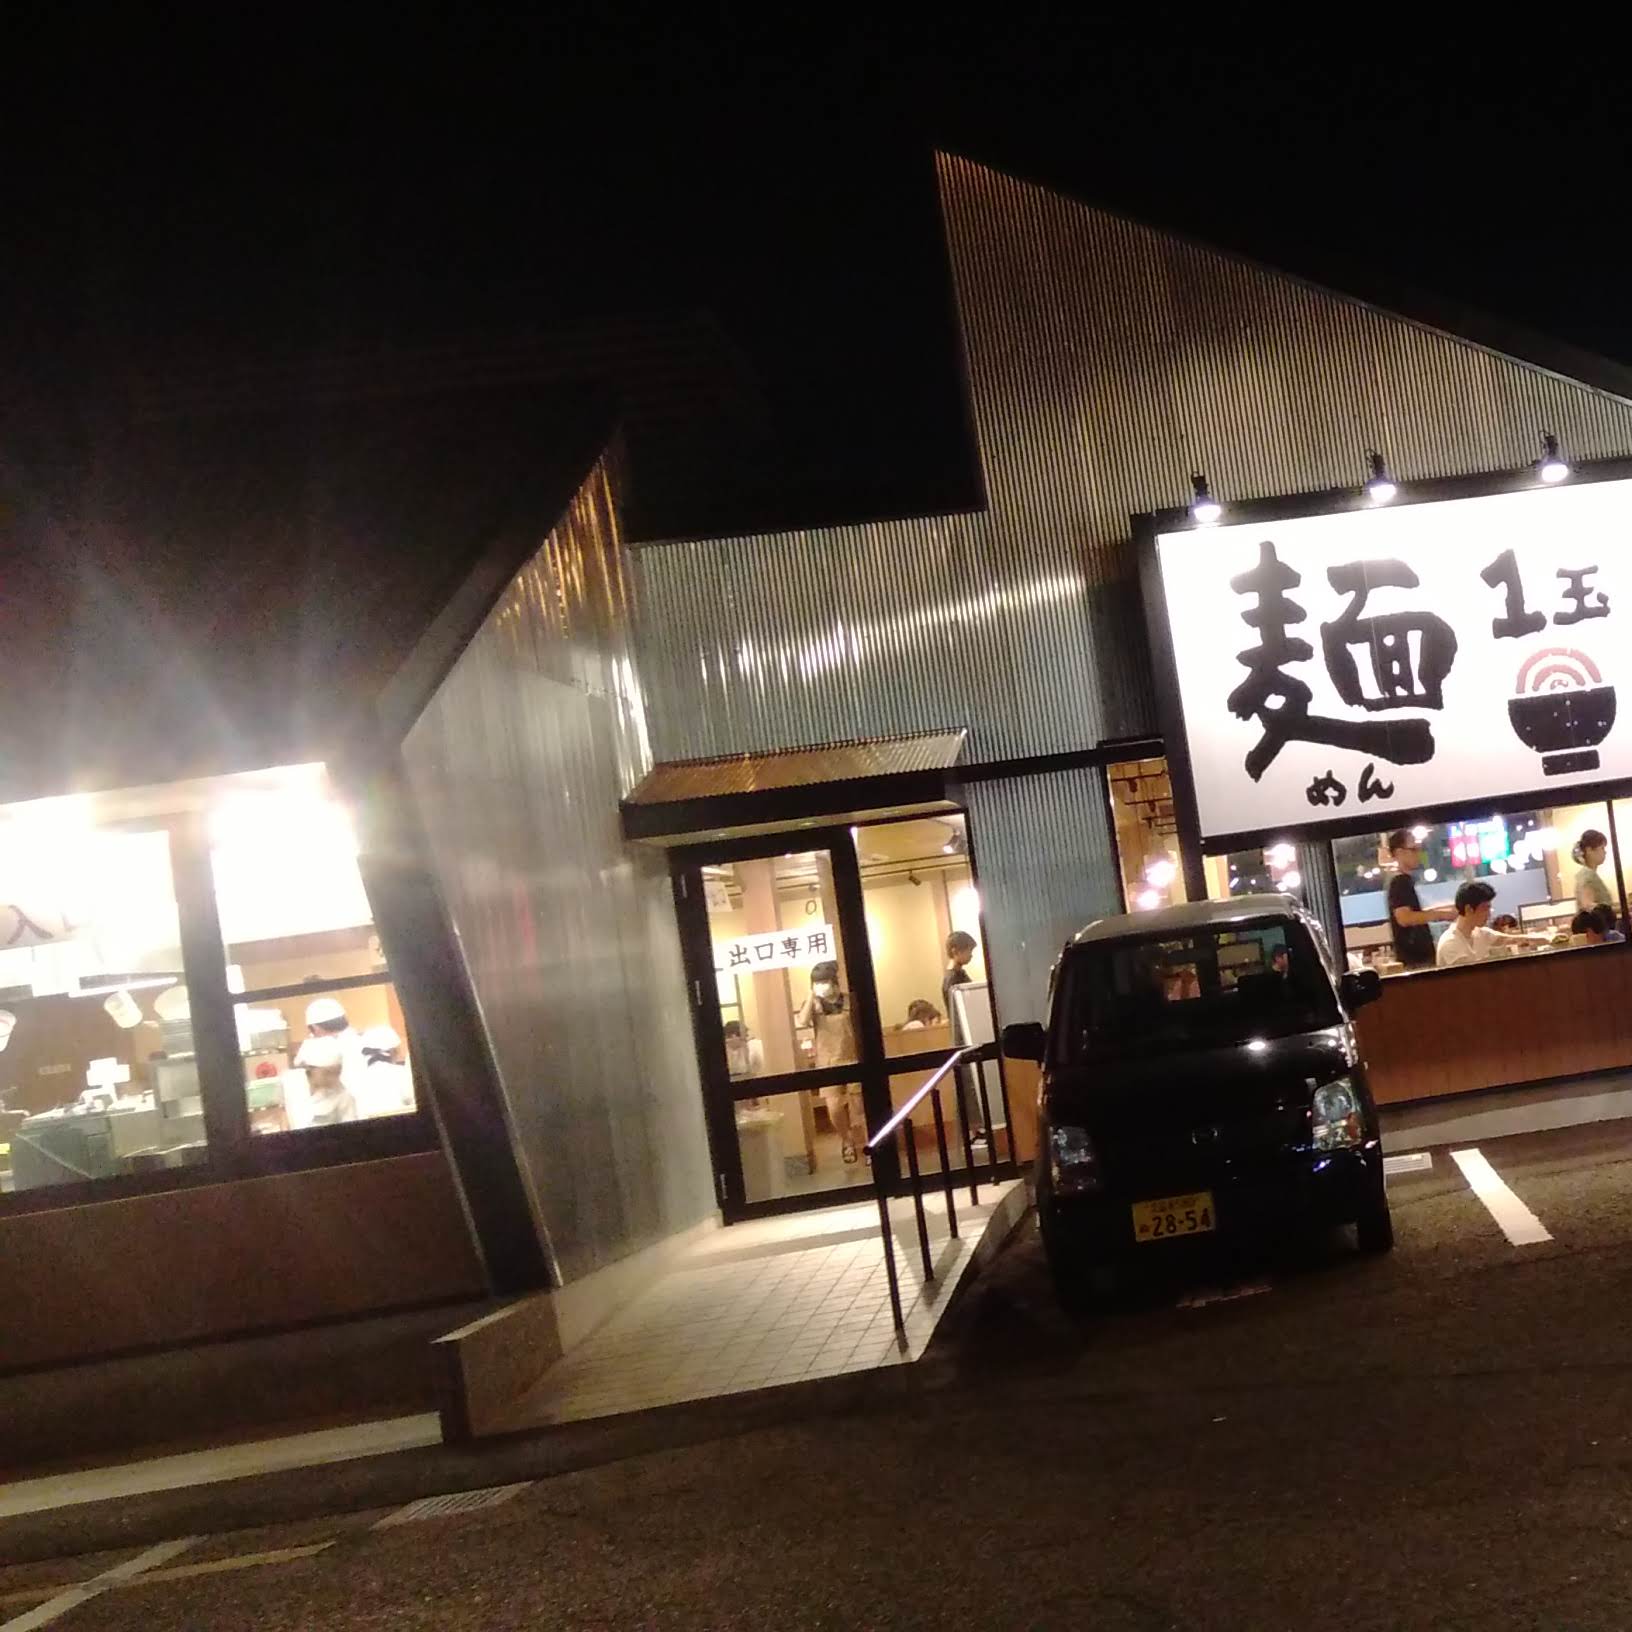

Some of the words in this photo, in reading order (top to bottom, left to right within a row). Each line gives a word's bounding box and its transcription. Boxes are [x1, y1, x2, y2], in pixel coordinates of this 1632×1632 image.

[1480, 549, 1611, 639] 1玉
[1227, 541, 1458, 782] 麺
[1306, 763, 1394, 807] めん
[728, 932, 828, 967] 出口専用
